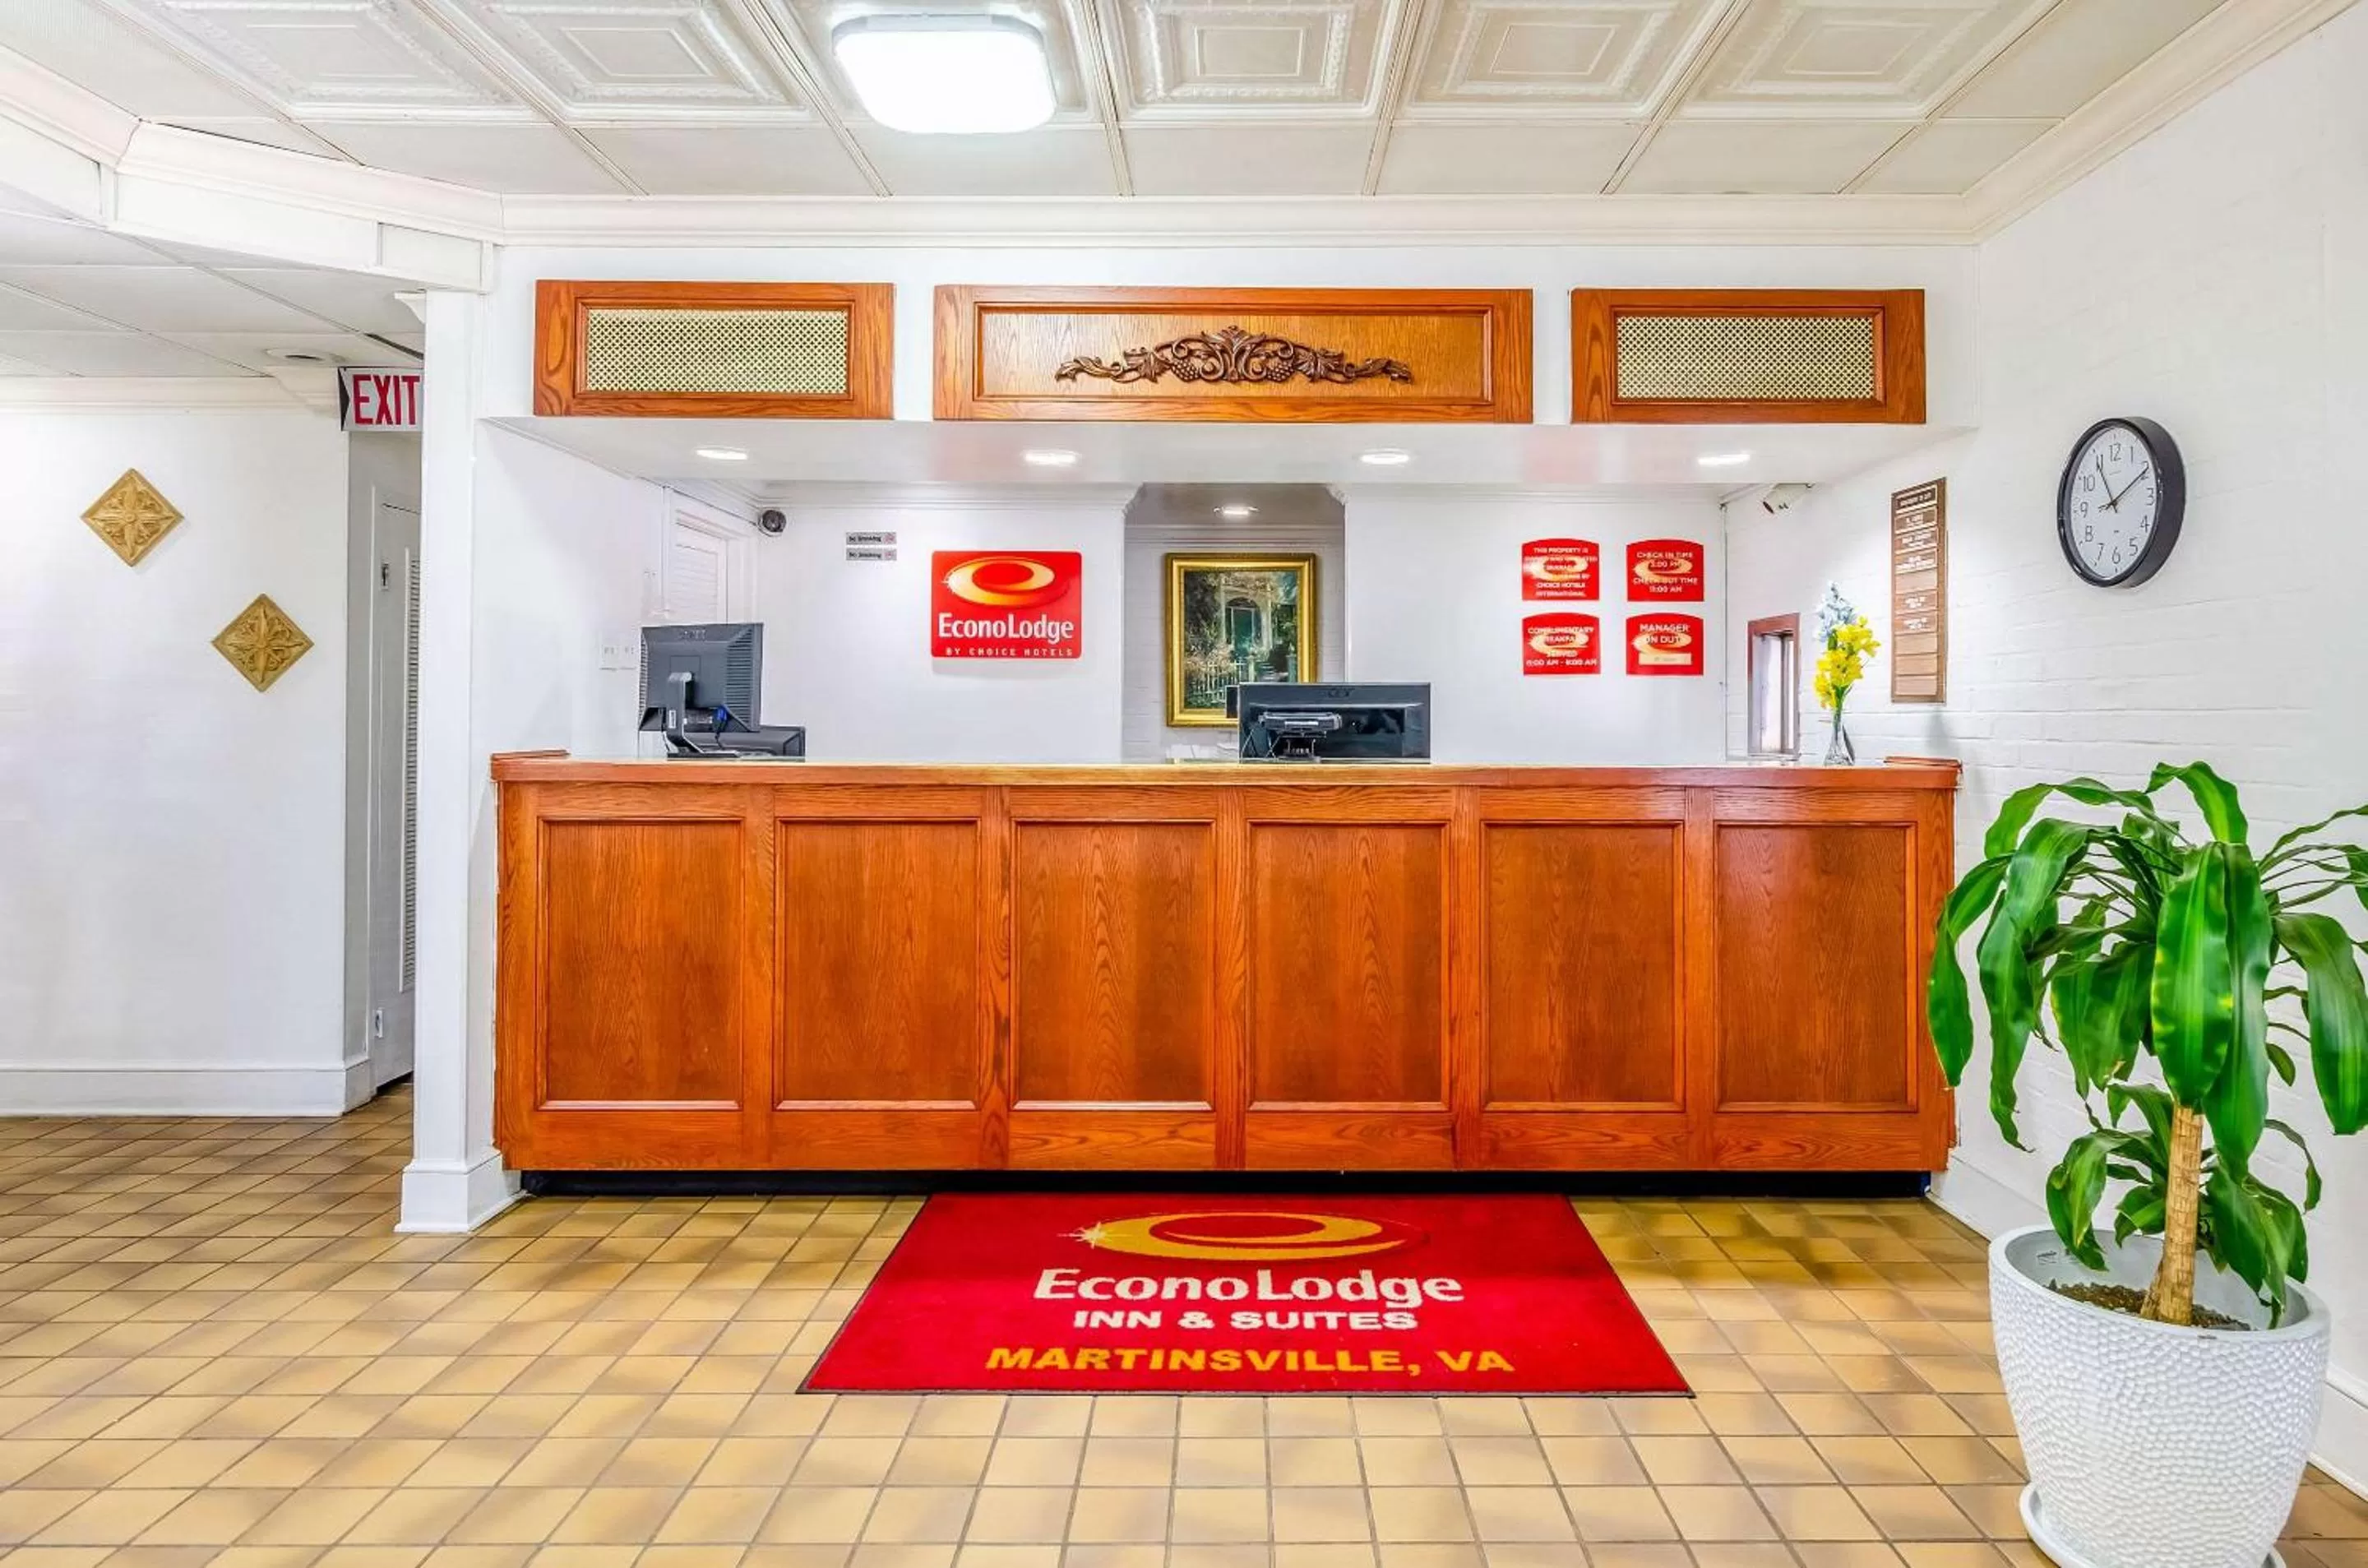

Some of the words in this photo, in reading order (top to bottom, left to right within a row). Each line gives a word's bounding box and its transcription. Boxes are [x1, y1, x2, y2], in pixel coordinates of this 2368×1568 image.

[353, 373, 420, 425] EXIT
[2109, 442, 2121, 461] 12
[2083, 474, 2095, 493] 10
[2145, 487, 2155, 506] 3
[2079, 502, 2088, 518] 9
[2139, 515, 2150, 533] 4
[2084, 525, 2093, 543] 8
[2097, 543, 2105, 561] 7
[2111, 546, 2121, 564] 6
[2129, 536, 2139, 557] 5
[938, 612, 1075, 645] EconoLodge
[1639, 623, 1690, 632] MANAGER
[1660, 636, 1686, 644] DUT
[946, 647, 960, 656] BY
[969, 647, 1017, 656] CHOICE
[1024, 647, 1073, 656] HOTELS
[1033, 1268, 1464, 1309] EconoLodge
[1073, 1310, 1162, 1329] INN
[1177, 1311, 1214, 1329] &
[1230, 1311, 1418, 1330] SUITES
[985, 1347, 1422, 1376] MARTINSVILLE,
[1435, 1349, 1515, 1371] VA
